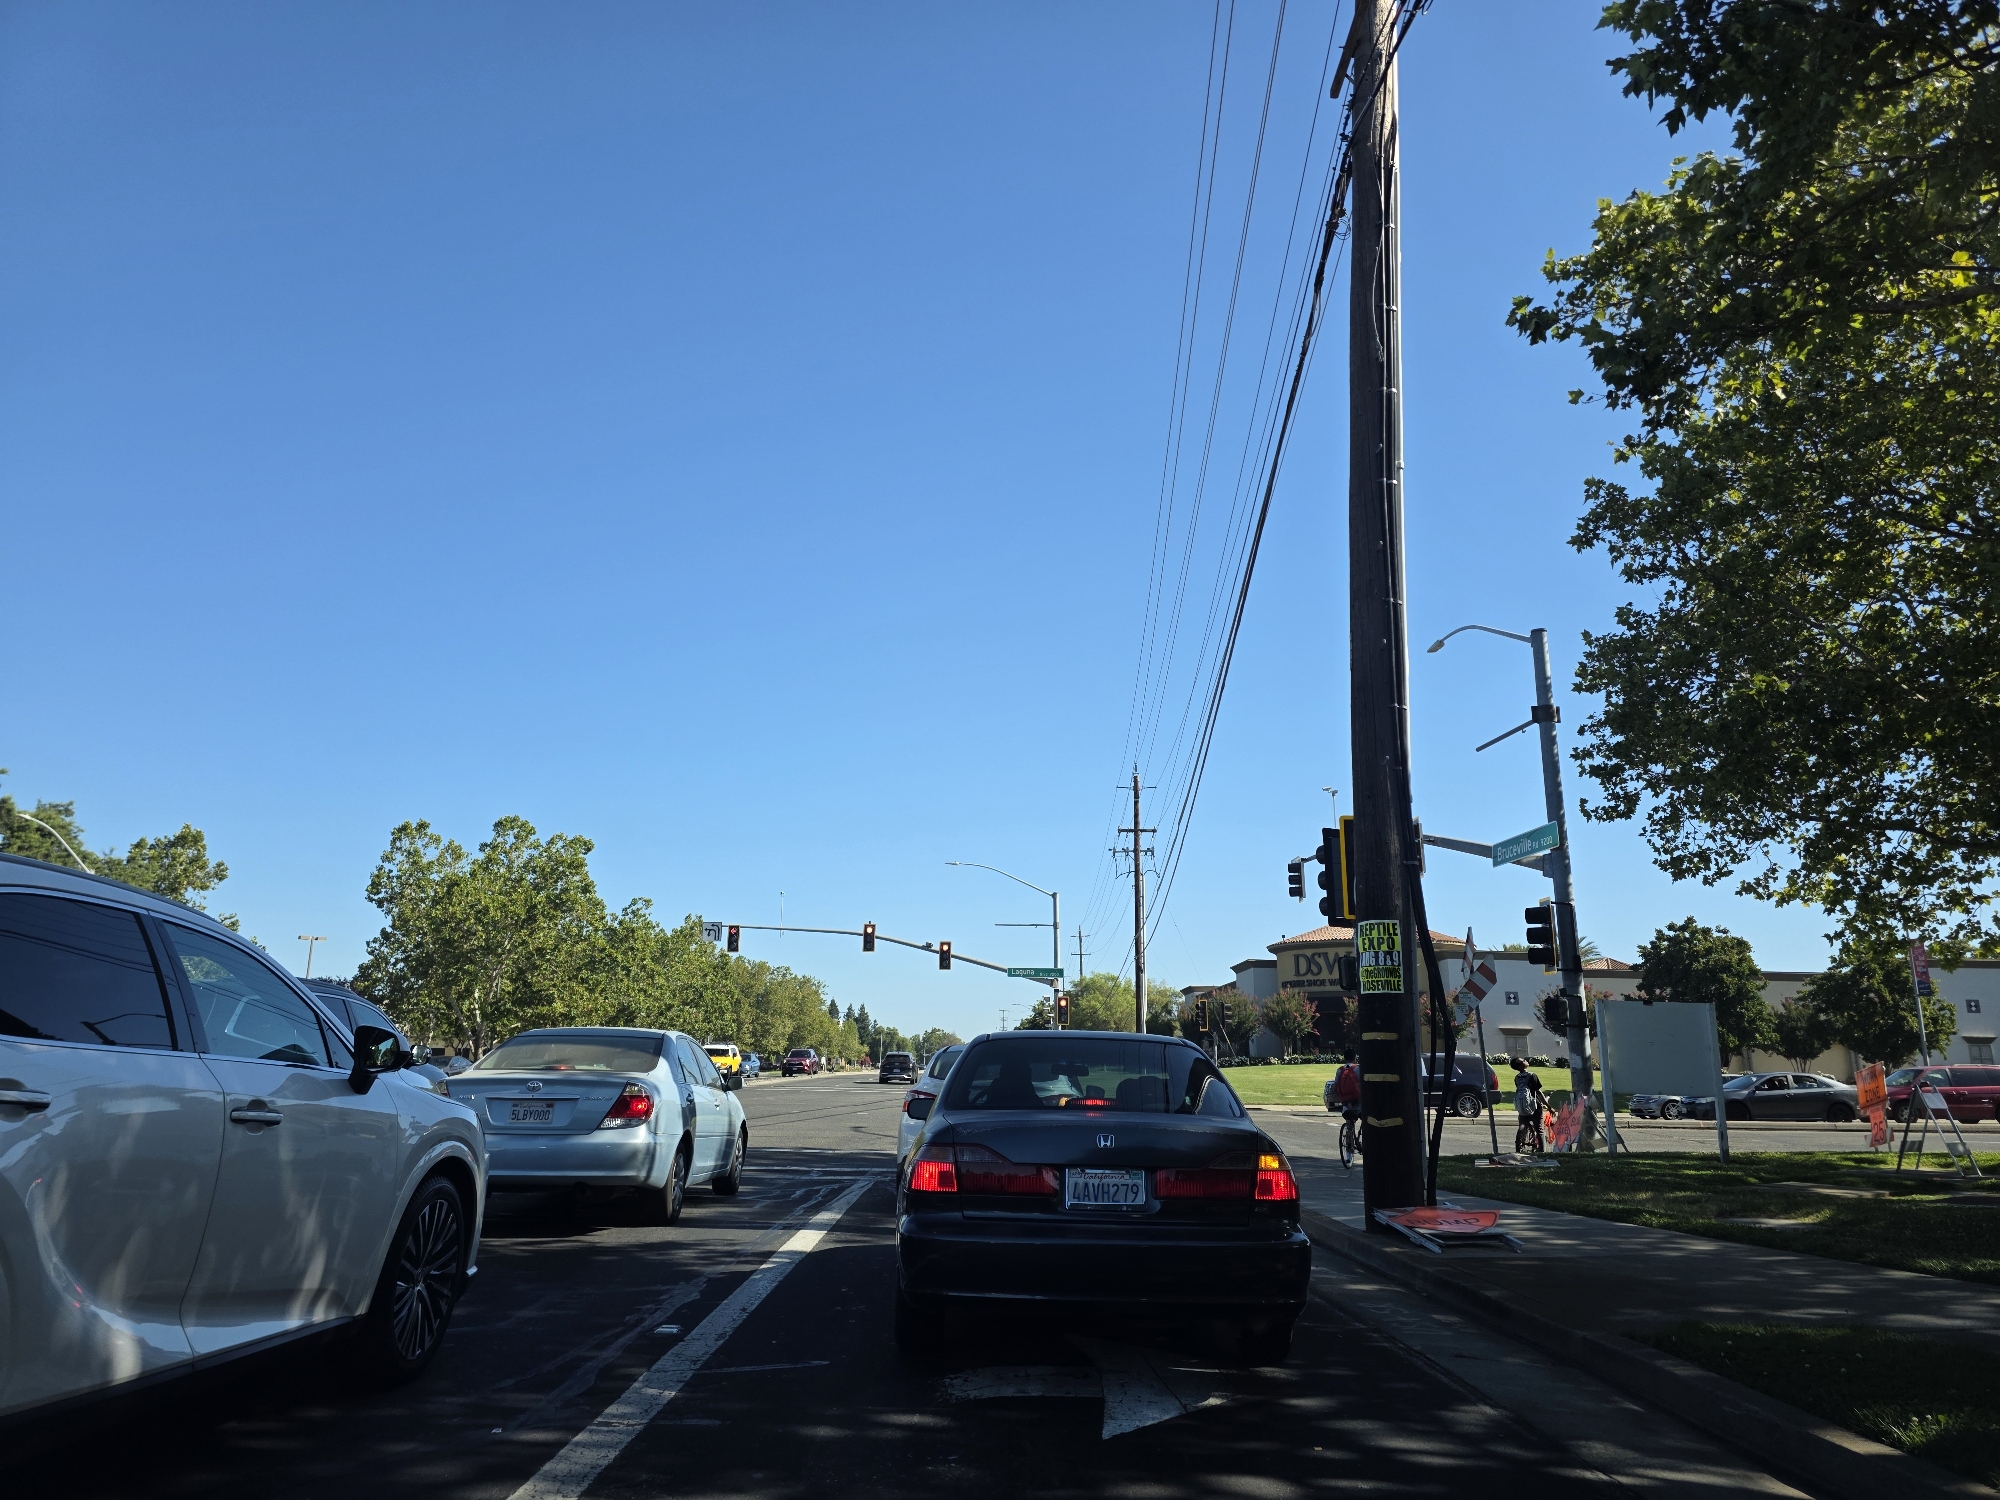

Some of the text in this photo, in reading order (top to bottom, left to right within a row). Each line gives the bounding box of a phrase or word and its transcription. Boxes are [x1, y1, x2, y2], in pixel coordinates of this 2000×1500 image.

[1497, 838, 1532, 861] Bruceville
[1360, 922, 1399, 938] REPTILE
[1362, 936, 1396, 951] EXPO
[1361, 951, 1399, 967] AUG 8 & 9
[1011, 968, 1035, 977] Laguna
[1362, 979, 1402, 992] ROSEVILLE
[1864, 1086, 1880, 1103] ZONE
[510, 1109, 551, 1121] 5LBY000
[1873, 1121, 1884, 1143] 25
[1083, 1173, 1125, 1182] California
[1072, 1181, 1140, 1203] 4AVH279
